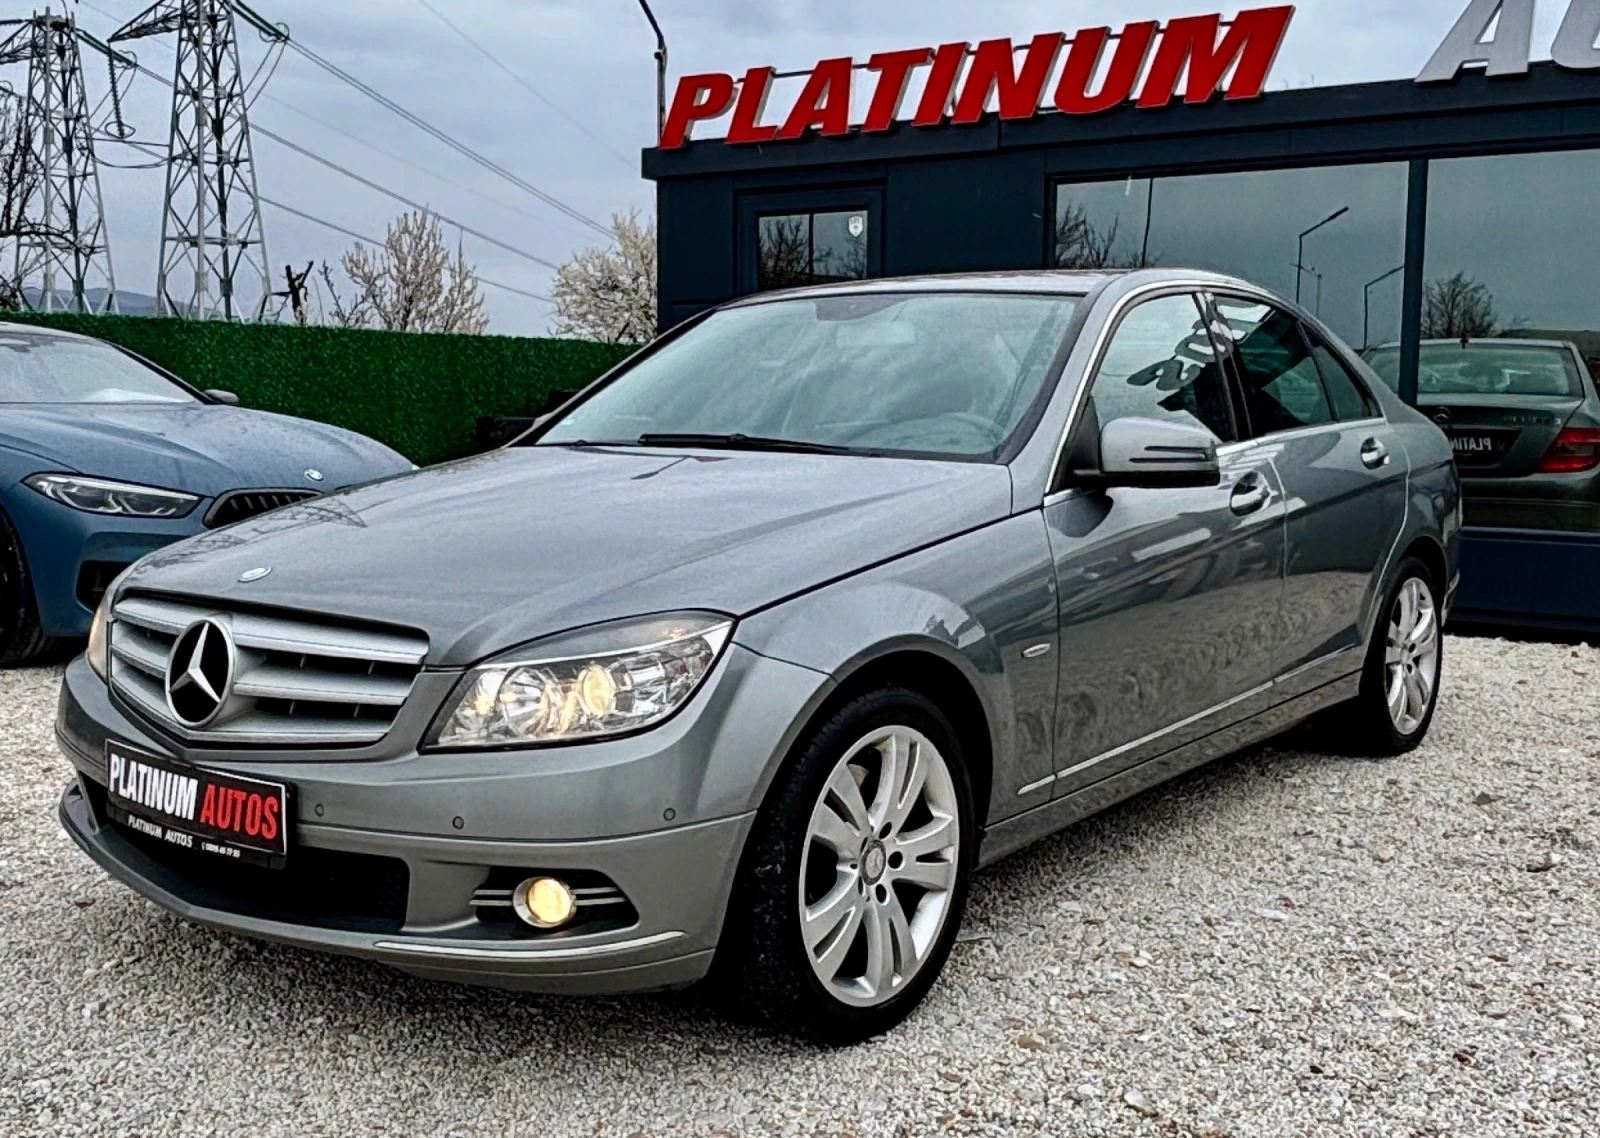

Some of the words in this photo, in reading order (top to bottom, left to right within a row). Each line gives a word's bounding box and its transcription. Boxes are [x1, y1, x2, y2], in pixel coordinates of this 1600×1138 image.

[658, 5, 1295, 149] PLATINUM
[109, 753, 198, 821] PLATINUM
[200, 783, 279, 840] AUTOS
[128, 814, 162, 839] PLATINUM
[164, 829, 193, 848] AUTOS
